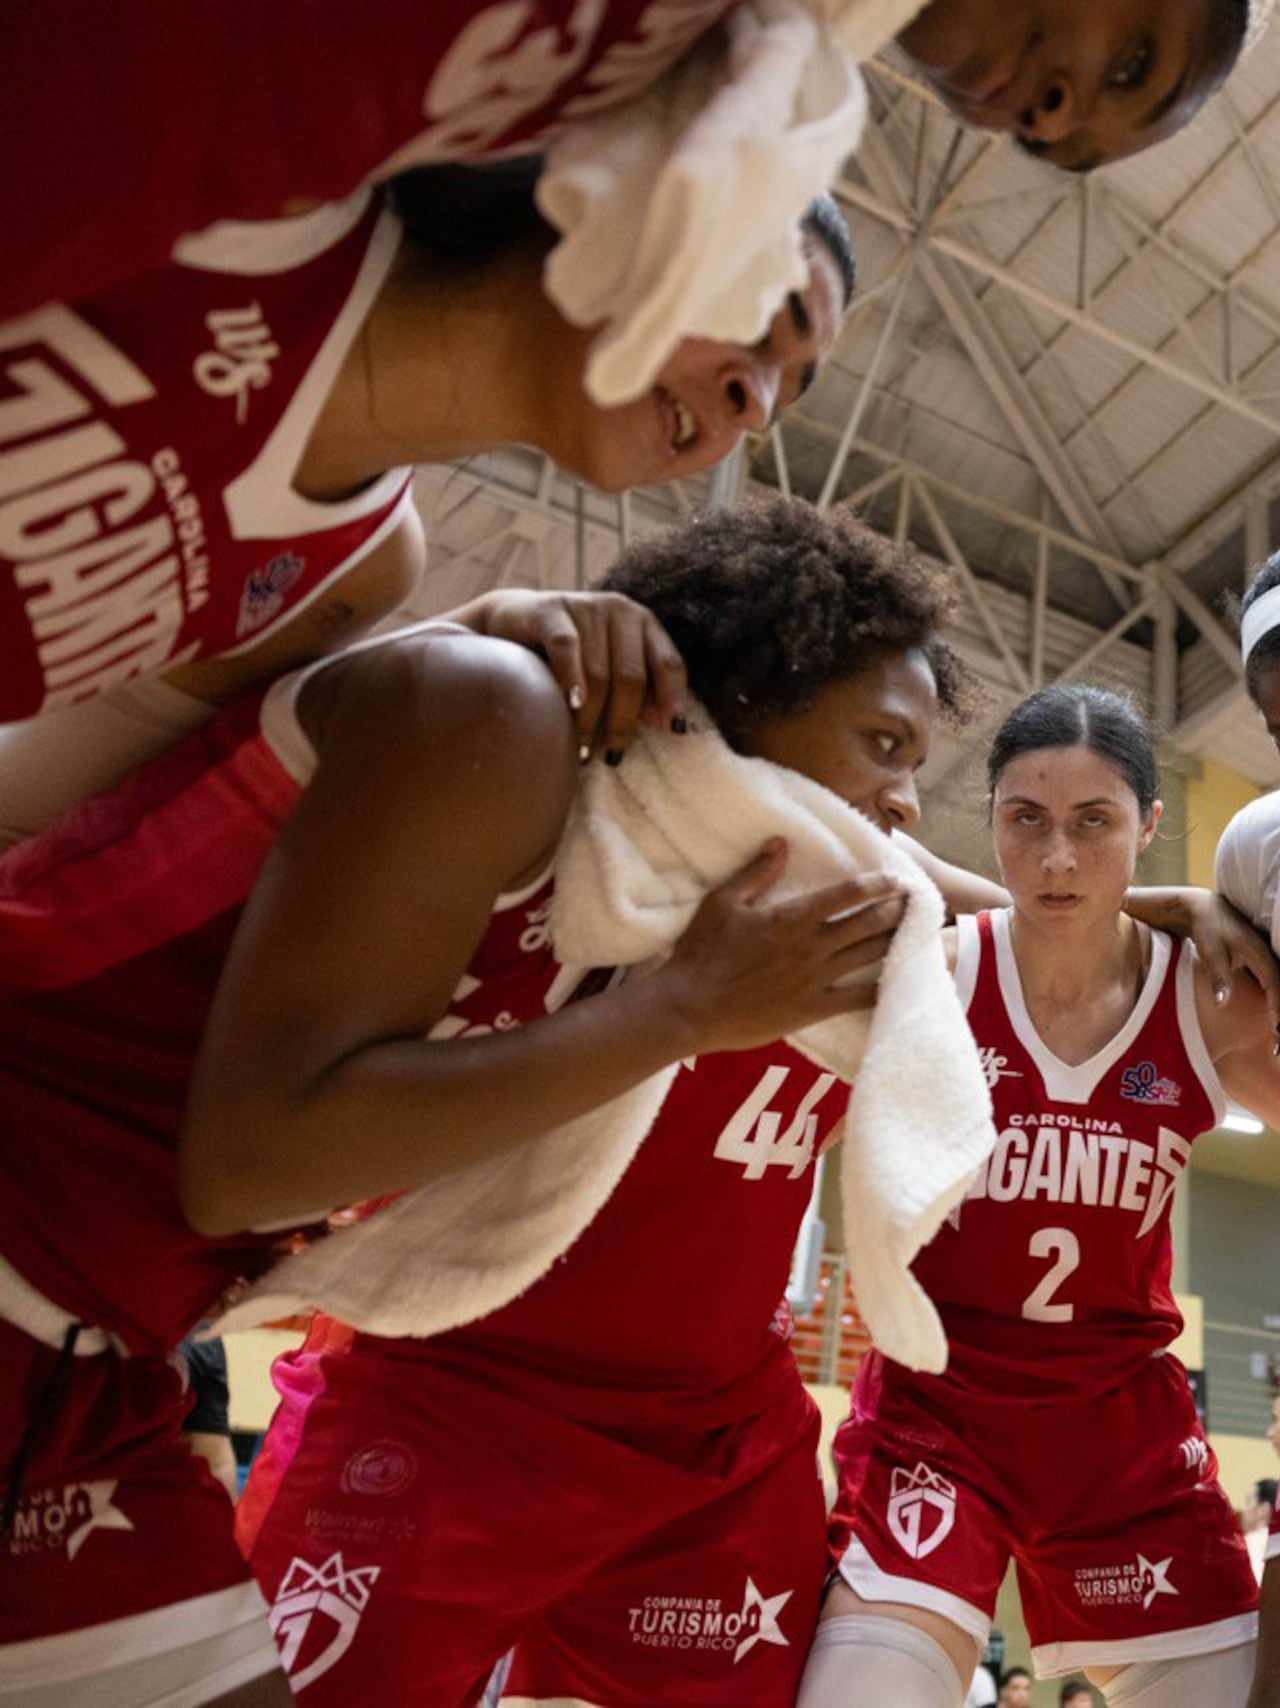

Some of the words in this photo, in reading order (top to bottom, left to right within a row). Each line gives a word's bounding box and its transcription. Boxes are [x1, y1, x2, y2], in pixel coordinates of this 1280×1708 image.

[713, 1064, 839, 1181] 44
[1008, 1113, 1124, 1135] CAROLINA
[1021, 1226, 1081, 1323] 2
[1073, 1576, 1144, 1598] TURISMO
[704, 1599, 722, 1612] DE
[628, 1608, 742, 1637] TURISMO
[632, 1633, 692, 1650] PUERTO
[694, 1636, 737, 1651] RICO
